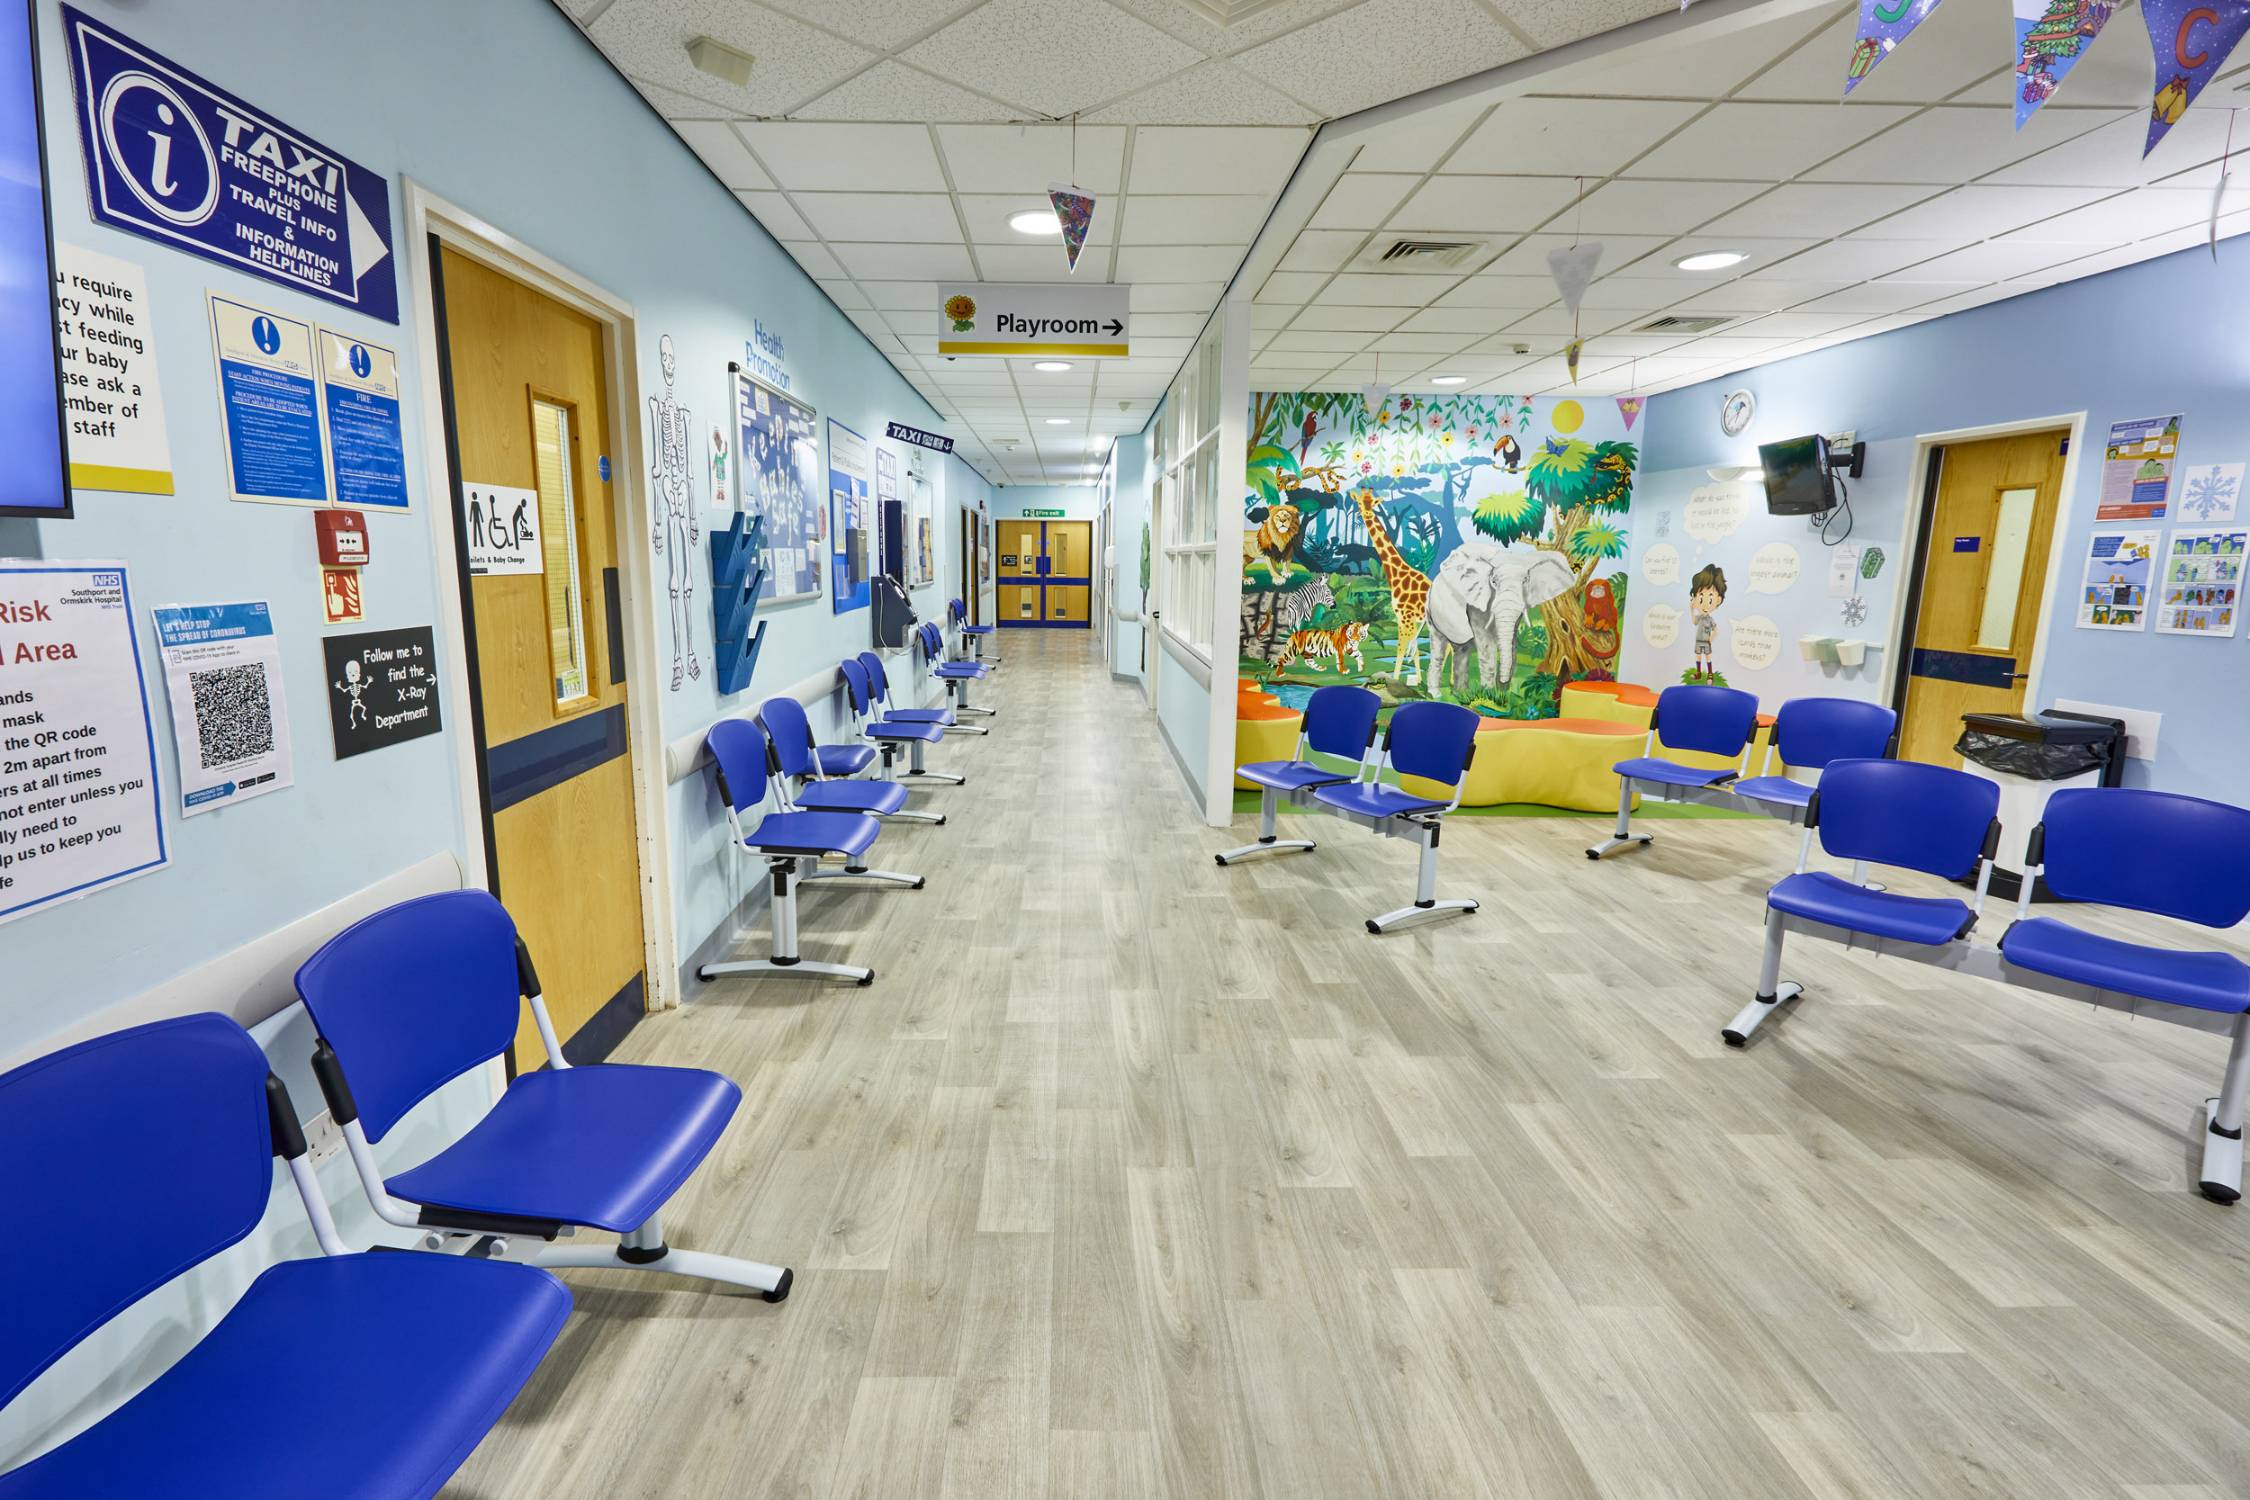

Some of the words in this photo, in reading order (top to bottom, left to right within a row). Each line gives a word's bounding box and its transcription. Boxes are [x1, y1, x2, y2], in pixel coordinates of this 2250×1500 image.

[2175, 7, 2221, 69] C
[216, 107, 339, 195] TAXI
[221, 148, 338, 213] FREEPHONE
[269, 187, 301, 211] PLUS
[230, 185, 296, 225] TRAVEL
[301, 216, 337, 242] INFO
[284, 226, 295, 240] &
[236, 223, 339, 275] INFORMATION
[250, 245, 332, 286] HELPLINES
[72, 274, 133, 302] require
[89, 303, 134, 326] while
[997, 313, 1098, 337] Playroom
[78, 322, 144, 354] feeding
[754, 319, 785, 362] Health
[86, 347, 128, 374] baby
[746, 341, 791, 391] Promotion
[97, 377, 125, 394] ask
[132, 384, 141, 396] a
[122, 403, 139, 419] of
[74, 420, 116, 438] staff
[892, 425, 921, 443] TAXI
[494, 556, 505, 564] Baby
[508, 556, 525, 564] Change
[94, 576, 118, 586] NHS
[60, 596, 93, 605] Ormskirk
[94, 596, 122, 605] Hospital
[71, 589, 107, 597] Southport
[166, 633, 177, 643] THE
[178, 631, 201, 642] SPREAD
[210, 626, 246, 638] CORONAVIRUS
[196, 620, 210, 629] STOP
[15, 642, 78, 664] Area
[363, 649, 393, 664] Follow
[396, 646, 410, 657] me
[413, 645, 422, 656] to
[388, 667, 407, 682] find
[410, 664, 425, 678] the
[397, 686, 427, 702] X-Ray
[3, 711, 45, 728] mask
[376, 706, 428, 729] Department
[5, 738, 30, 751] the
[34, 731, 58, 747] QR
[62, 725, 97, 741] code
[4, 761, 28, 774] 2m
[32, 752, 71, 769] apart
[74, 746, 107, 760] from
[23, 781, 38, 793] at
[42, 774, 60, 789] all
[63, 767, 102, 784] times
[0, 806, 24, 821] not
[28, 796, 67, 814] enter
[70, 784, 116, 804] unless
[119, 778, 144, 795] you
[22, 818, 58, 838] need
[62, 815, 77, 827] to
[17, 847, 37, 861] us
[40, 842, 55, 855] to
[59, 831, 93, 850] keep
[96, 823, 122, 842] you
